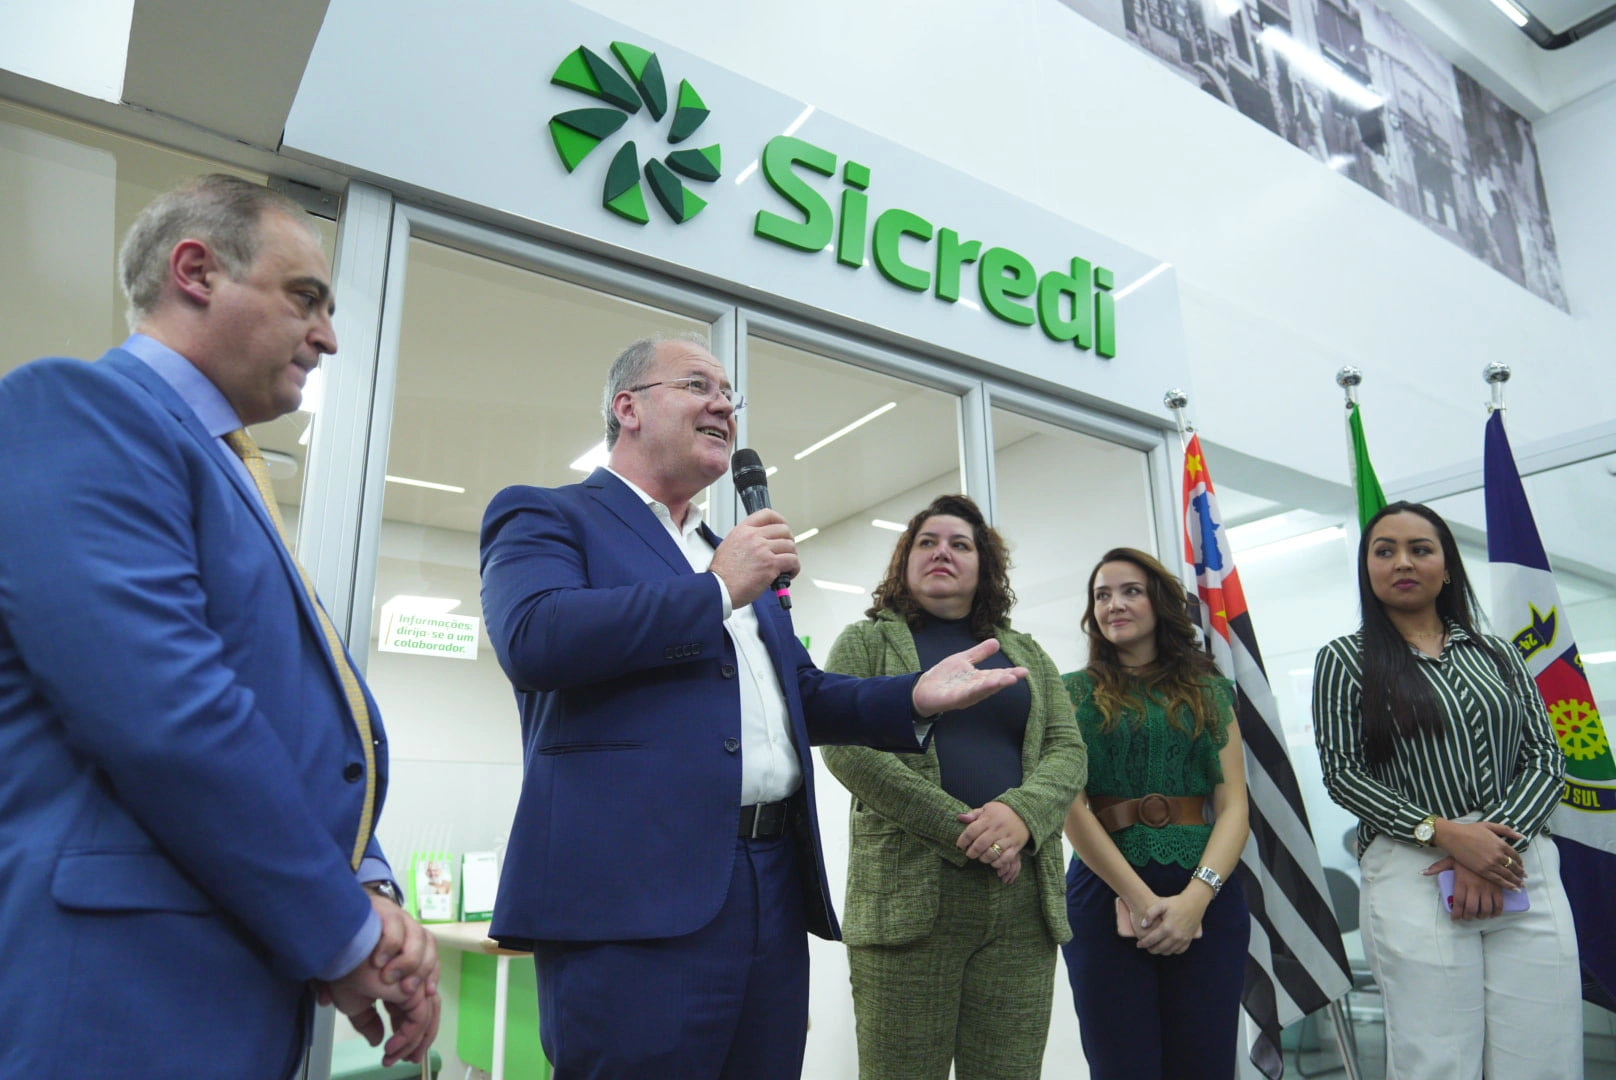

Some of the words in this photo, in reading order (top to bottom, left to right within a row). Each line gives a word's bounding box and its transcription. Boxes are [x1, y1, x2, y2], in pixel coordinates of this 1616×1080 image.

[754, 135, 1116, 359] Sicredi
[457, 634, 474, 642] um
[1573, 787, 1600, 807] SUL
